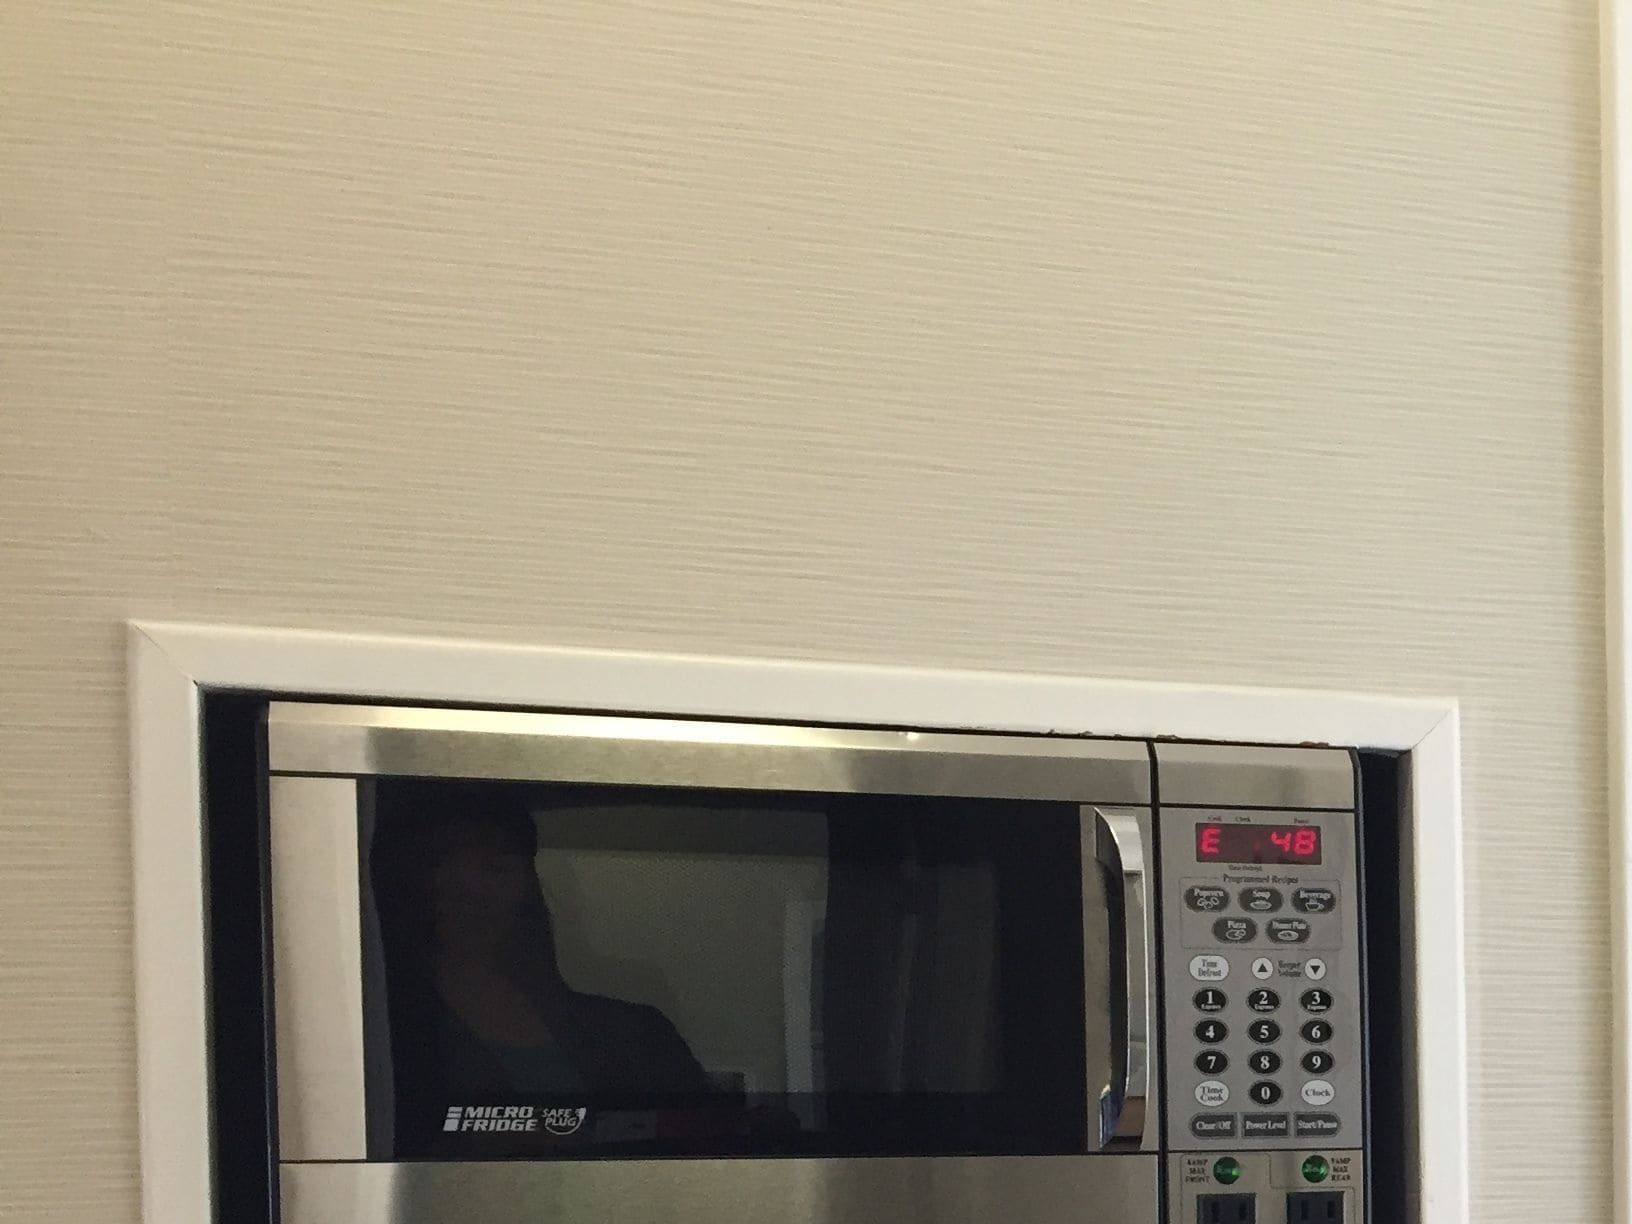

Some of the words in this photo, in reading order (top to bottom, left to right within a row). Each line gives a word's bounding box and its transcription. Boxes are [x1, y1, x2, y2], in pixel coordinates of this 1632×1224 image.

[1201, 827, 1220, 853] E
[1271, 828, 1316, 855] 48
[1206, 991, 1214, 1004] 1
[1259, 991, 1269, 1004] 2
[1311, 992, 1321, 1005] 3
[1205, 1025, 1215, 1038] 4
[1260, 1025, 1269, 1038] 5
[1311, 1025, 1321, 1039] 6
[1207, 1056, 1217, 1069] 7
[1260, 1056, 1270, 1069] 8
[1312, 1055, 1321, 1069] 9
[1261, 1086, 1270, 1100] 0
[1305, 1088, 1331, 1097] Clock
[464, 1106, 534, 1119] MICRO
[542, 1108, 572, 1118] SAFE
[461, 1119, 539, 1132] FRIDGE
[545, 1117, 577, 1127] PLUG
